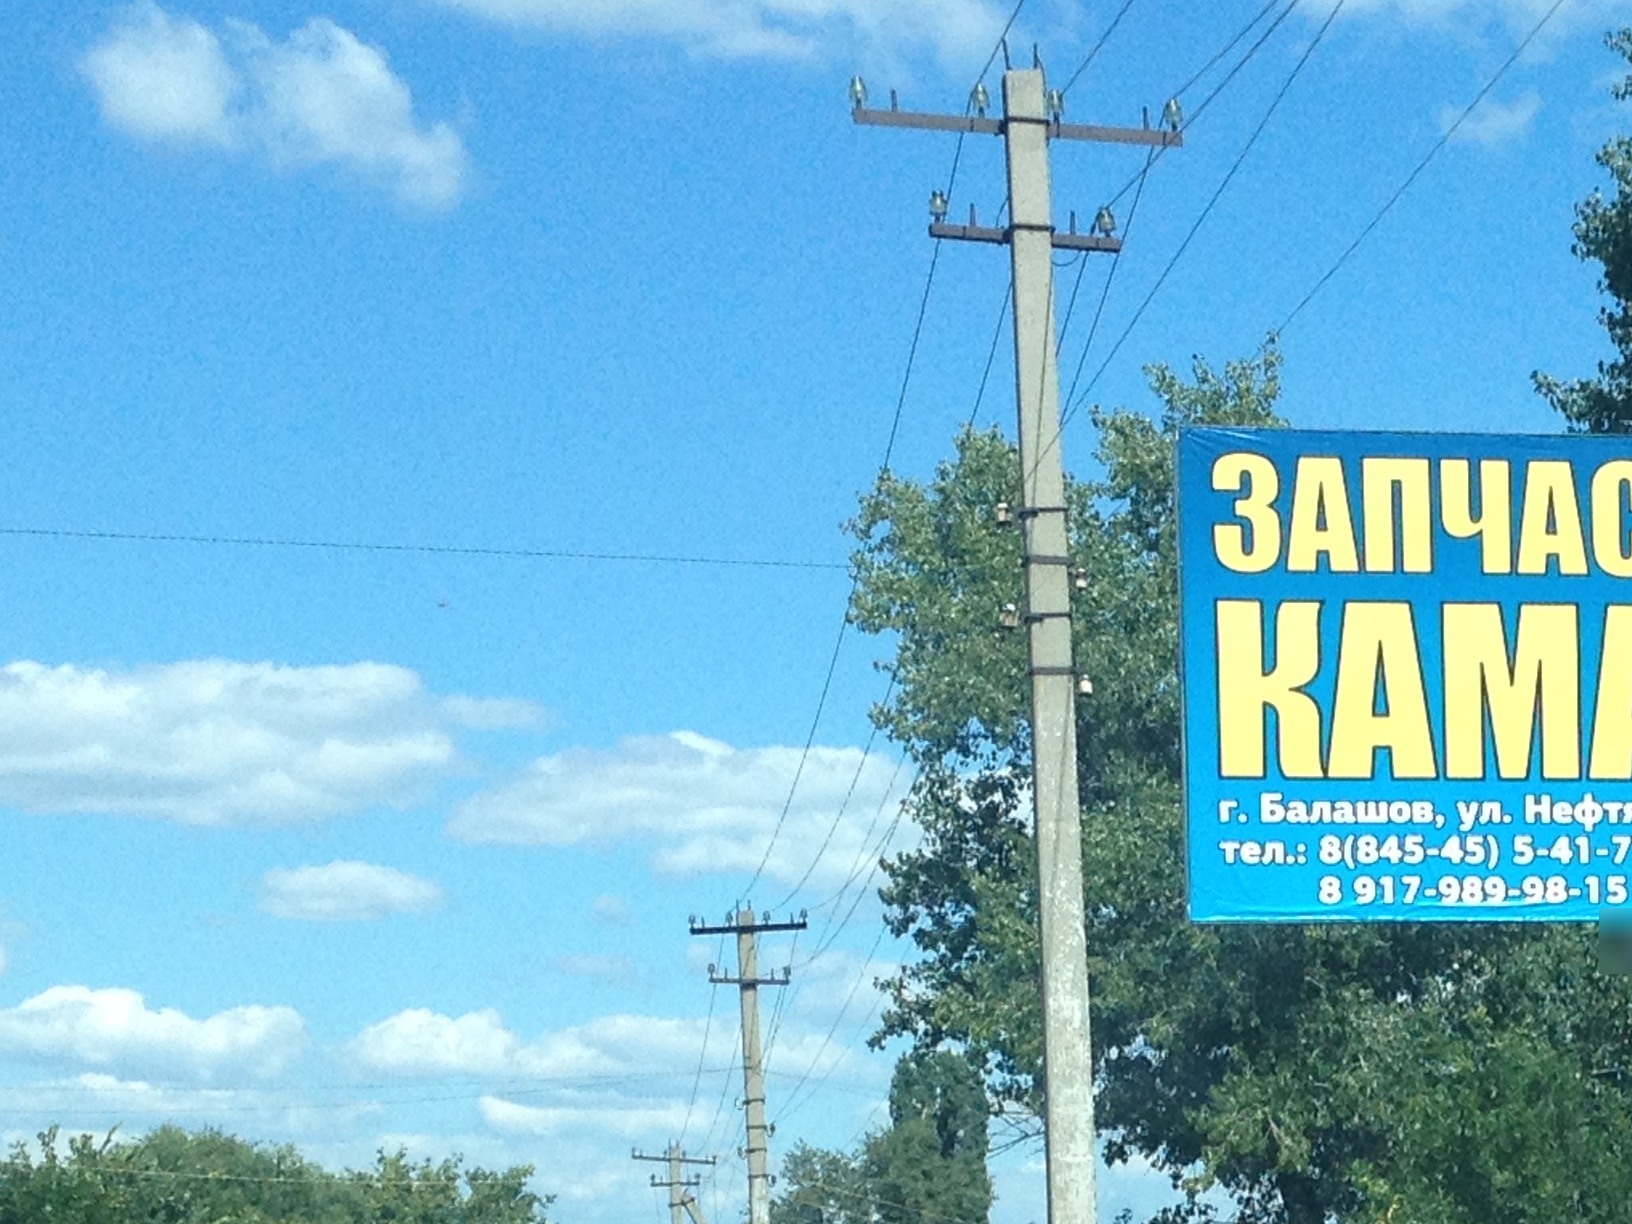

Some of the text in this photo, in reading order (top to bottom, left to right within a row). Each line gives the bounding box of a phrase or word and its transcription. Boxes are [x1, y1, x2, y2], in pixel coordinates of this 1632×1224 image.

[1217, 799, 1249, 824] г.
[1259, 791, 1446, 830] Балашов,
[1455, 799, 1514, 833] ул.
[1218, 840, 1308, 865] тел.:
[1317, 833, 1500, 871] 8(845-45)
[1317, 873, 1629, 907] 8 917-989-98-15
